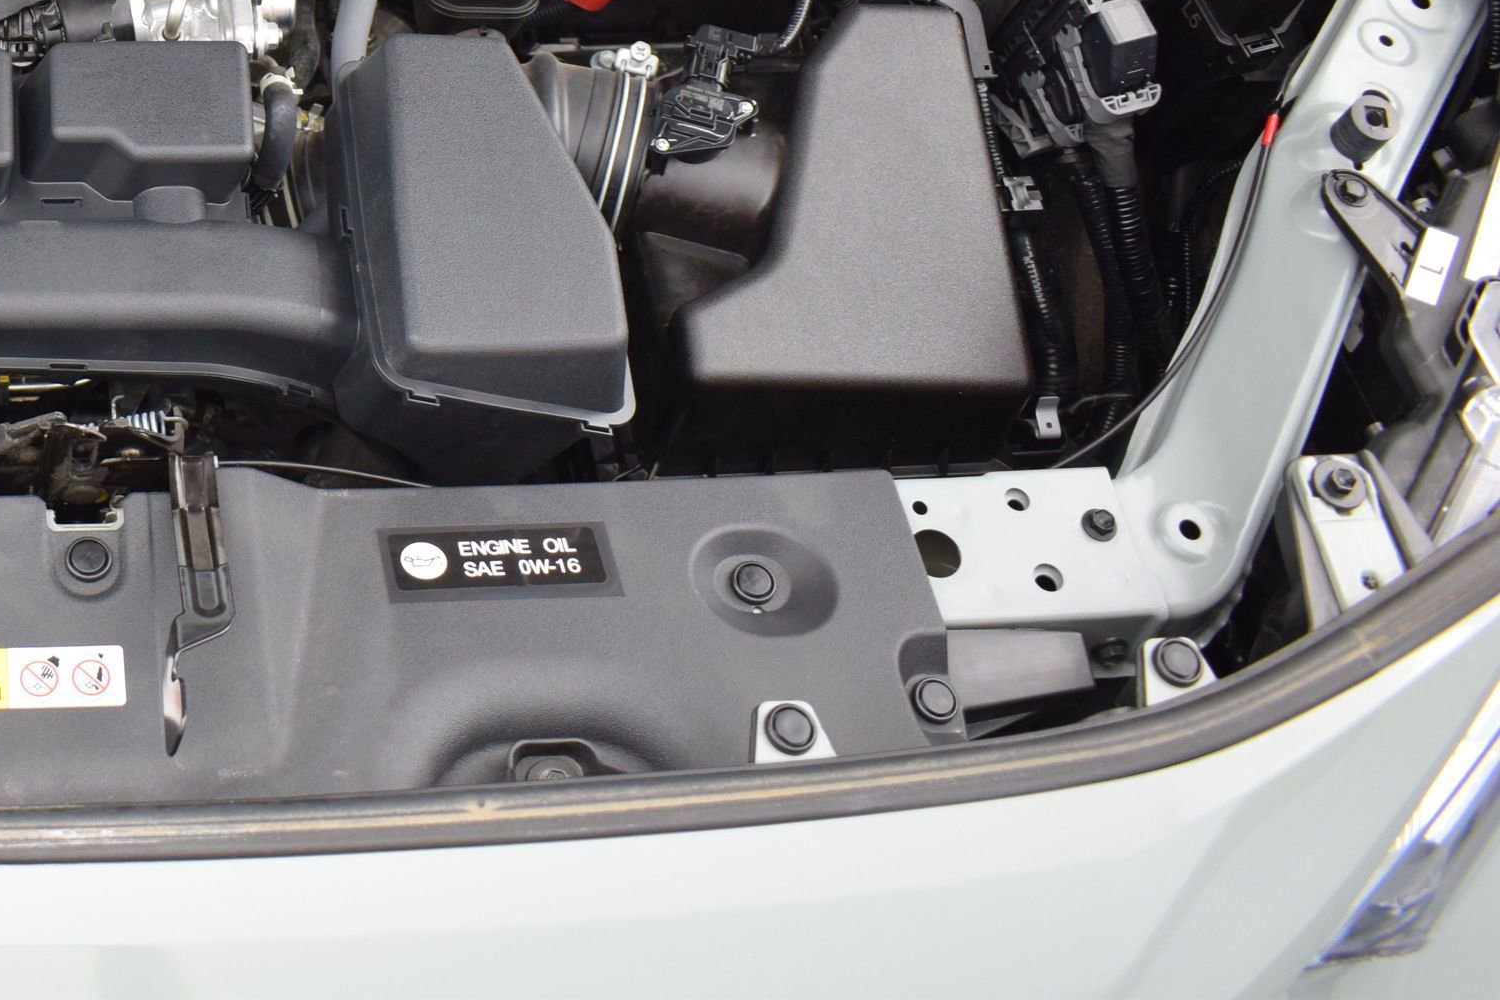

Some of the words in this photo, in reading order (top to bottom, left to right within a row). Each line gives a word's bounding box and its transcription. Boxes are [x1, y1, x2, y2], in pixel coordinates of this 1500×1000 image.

[457, 537, 533, 557] ENGINE
[542, 537, 578, 554] OIL
[463, 559, 507, 578] SAE
[518, 557, 583, 575] 0W-16
